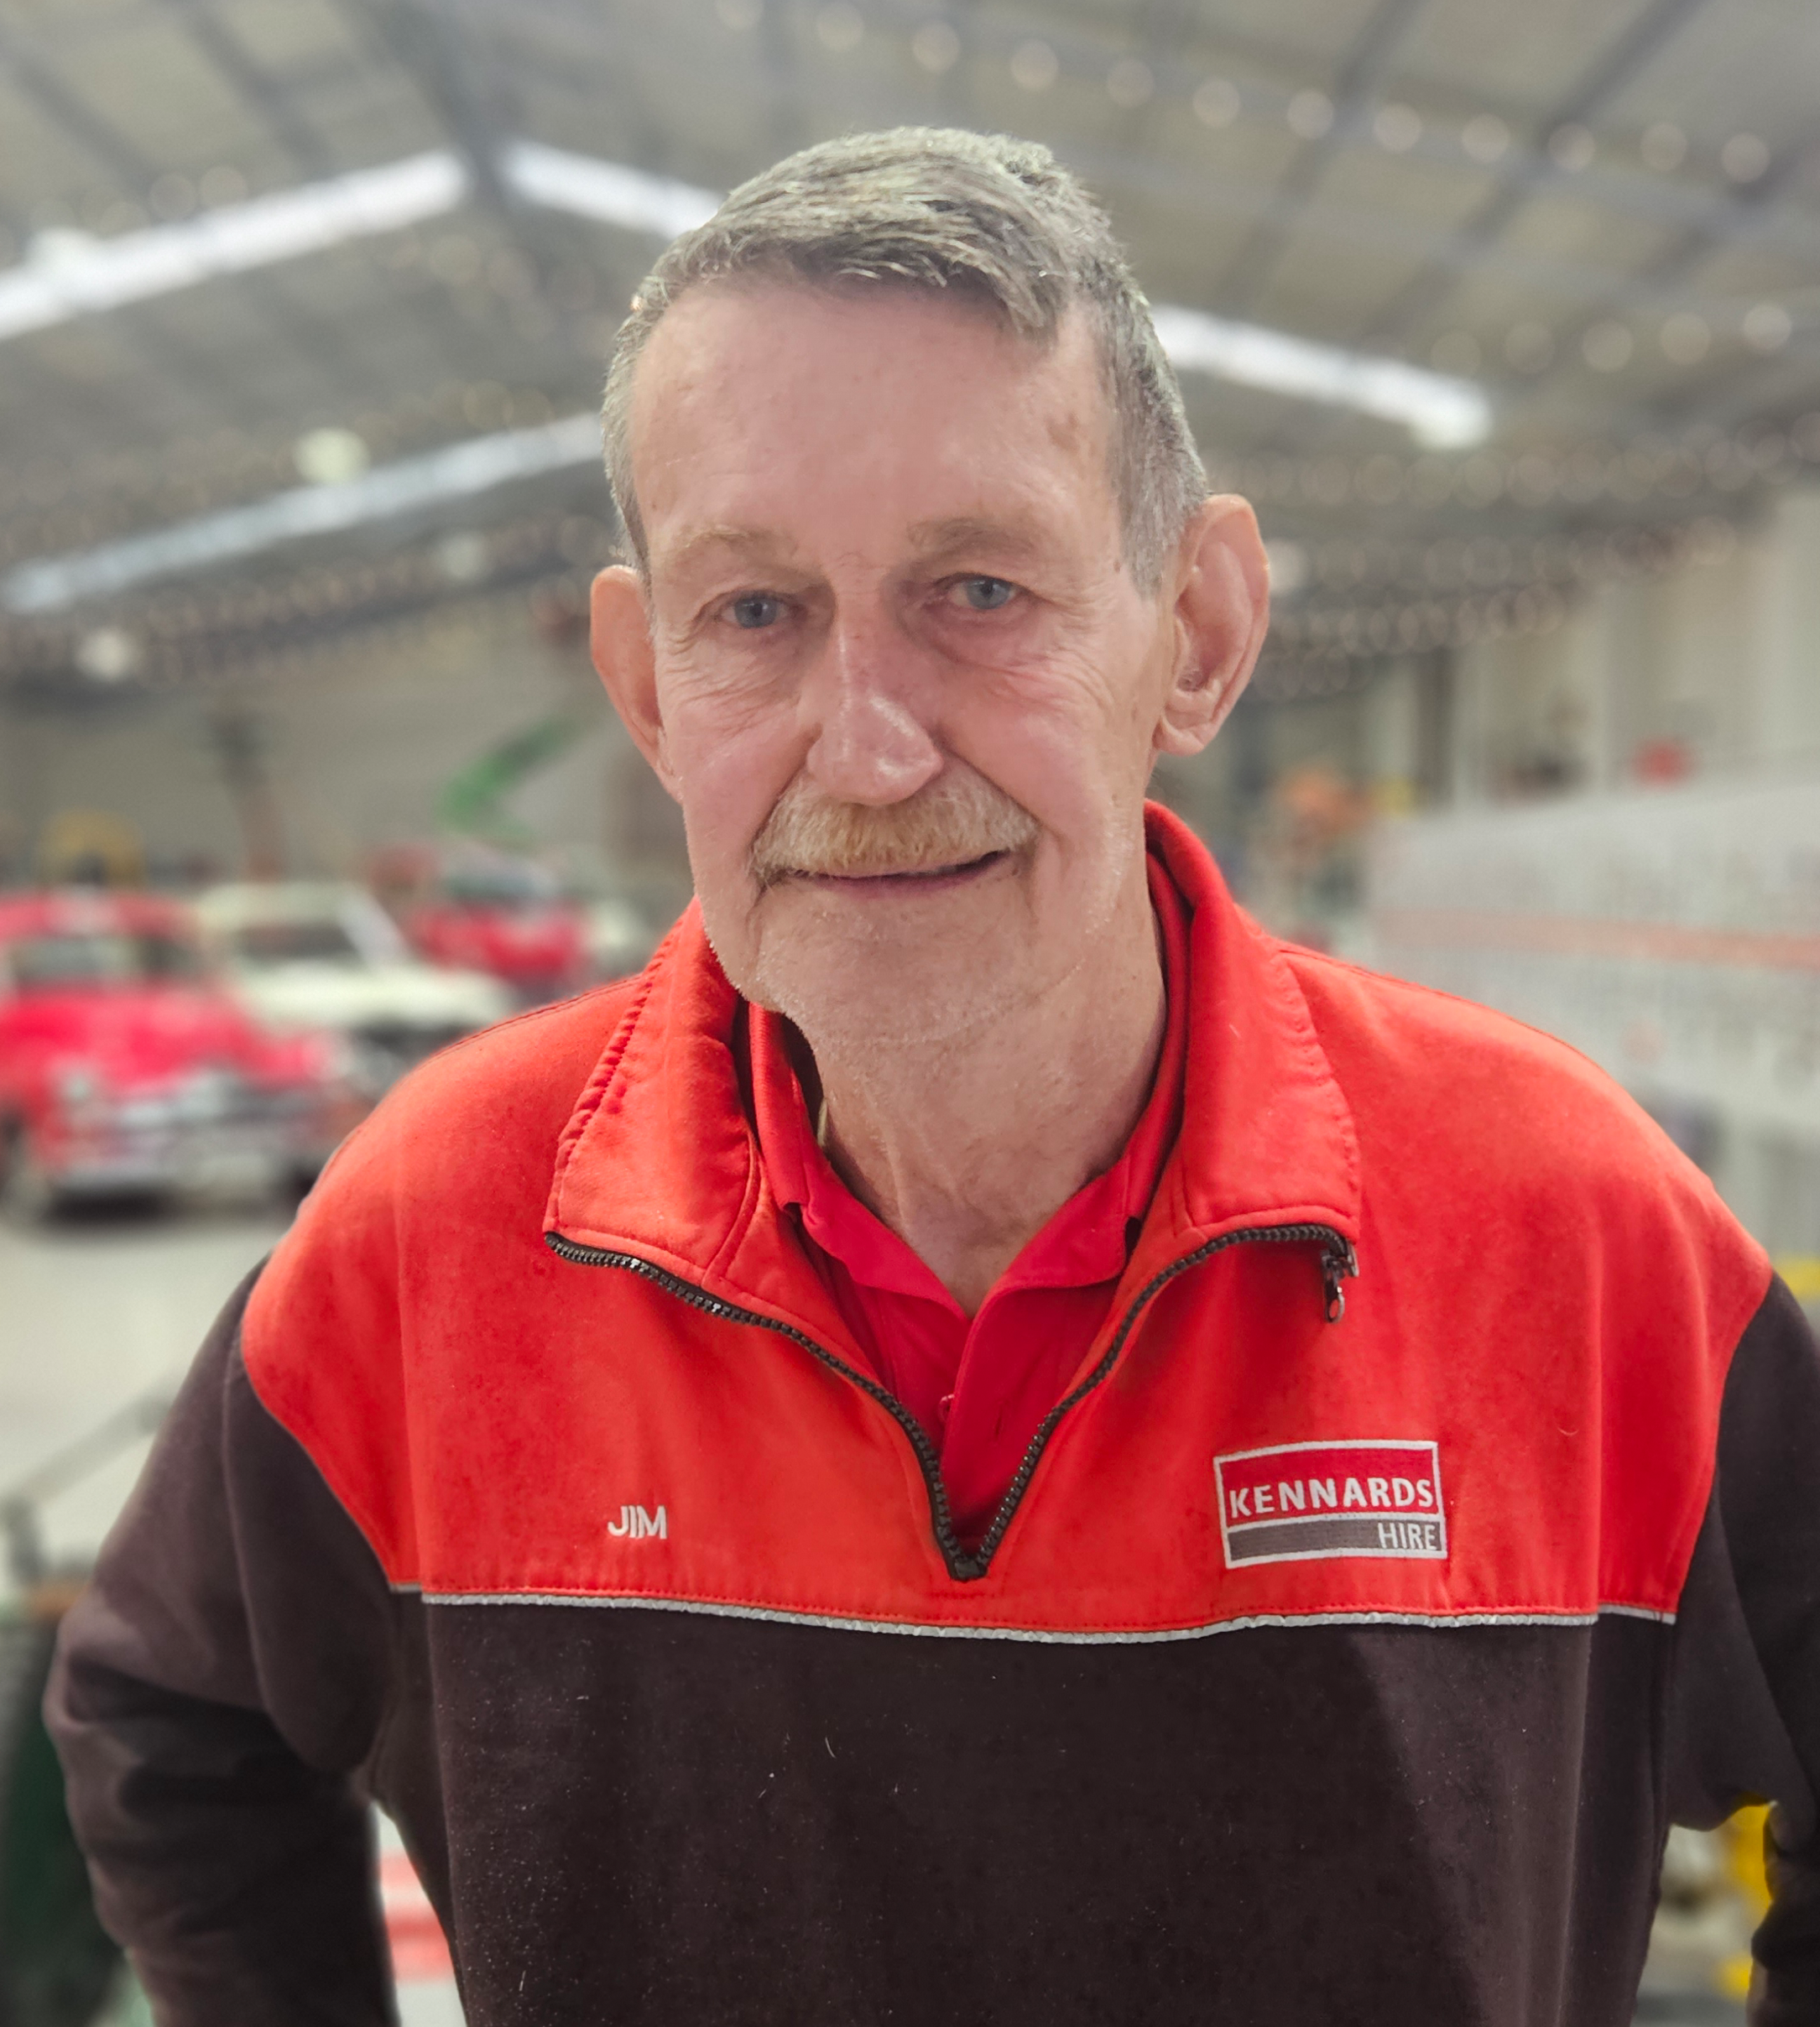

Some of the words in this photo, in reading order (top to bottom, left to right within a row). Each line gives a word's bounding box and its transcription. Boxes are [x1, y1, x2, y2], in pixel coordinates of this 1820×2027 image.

[1228, 1477, 1434, 1519] KENNARDS
[608, 1504, 668, 1540] JIM
[1378, 1522, 1437, 1550] HIRE
